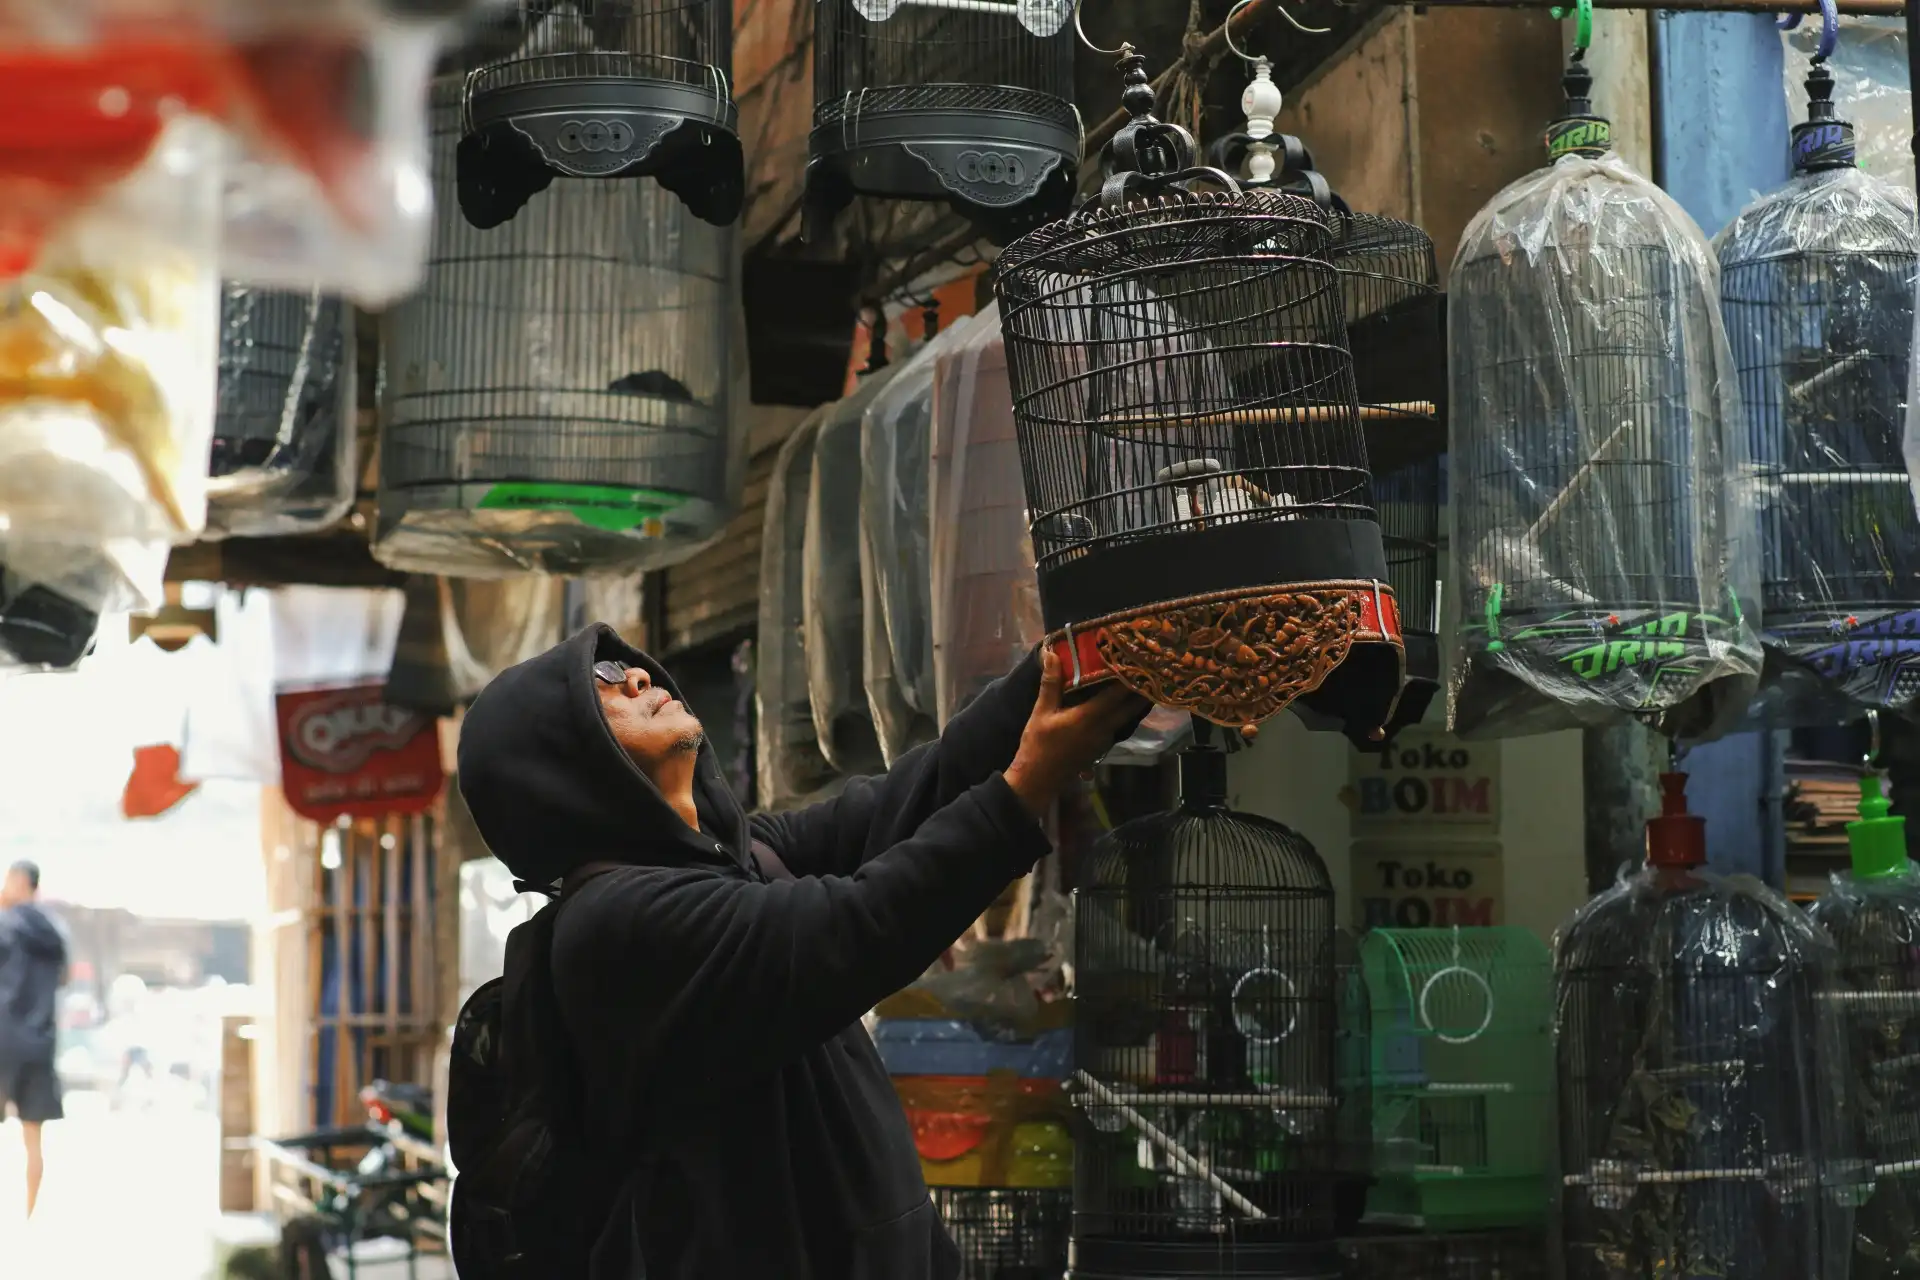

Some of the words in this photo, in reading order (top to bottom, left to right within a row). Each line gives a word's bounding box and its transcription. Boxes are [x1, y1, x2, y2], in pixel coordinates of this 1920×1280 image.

[1379, 742, 1469, 769] Toko
[1358, 776, 1491, 815] BOIM
[1377, 861, 1473, 889] Toko
